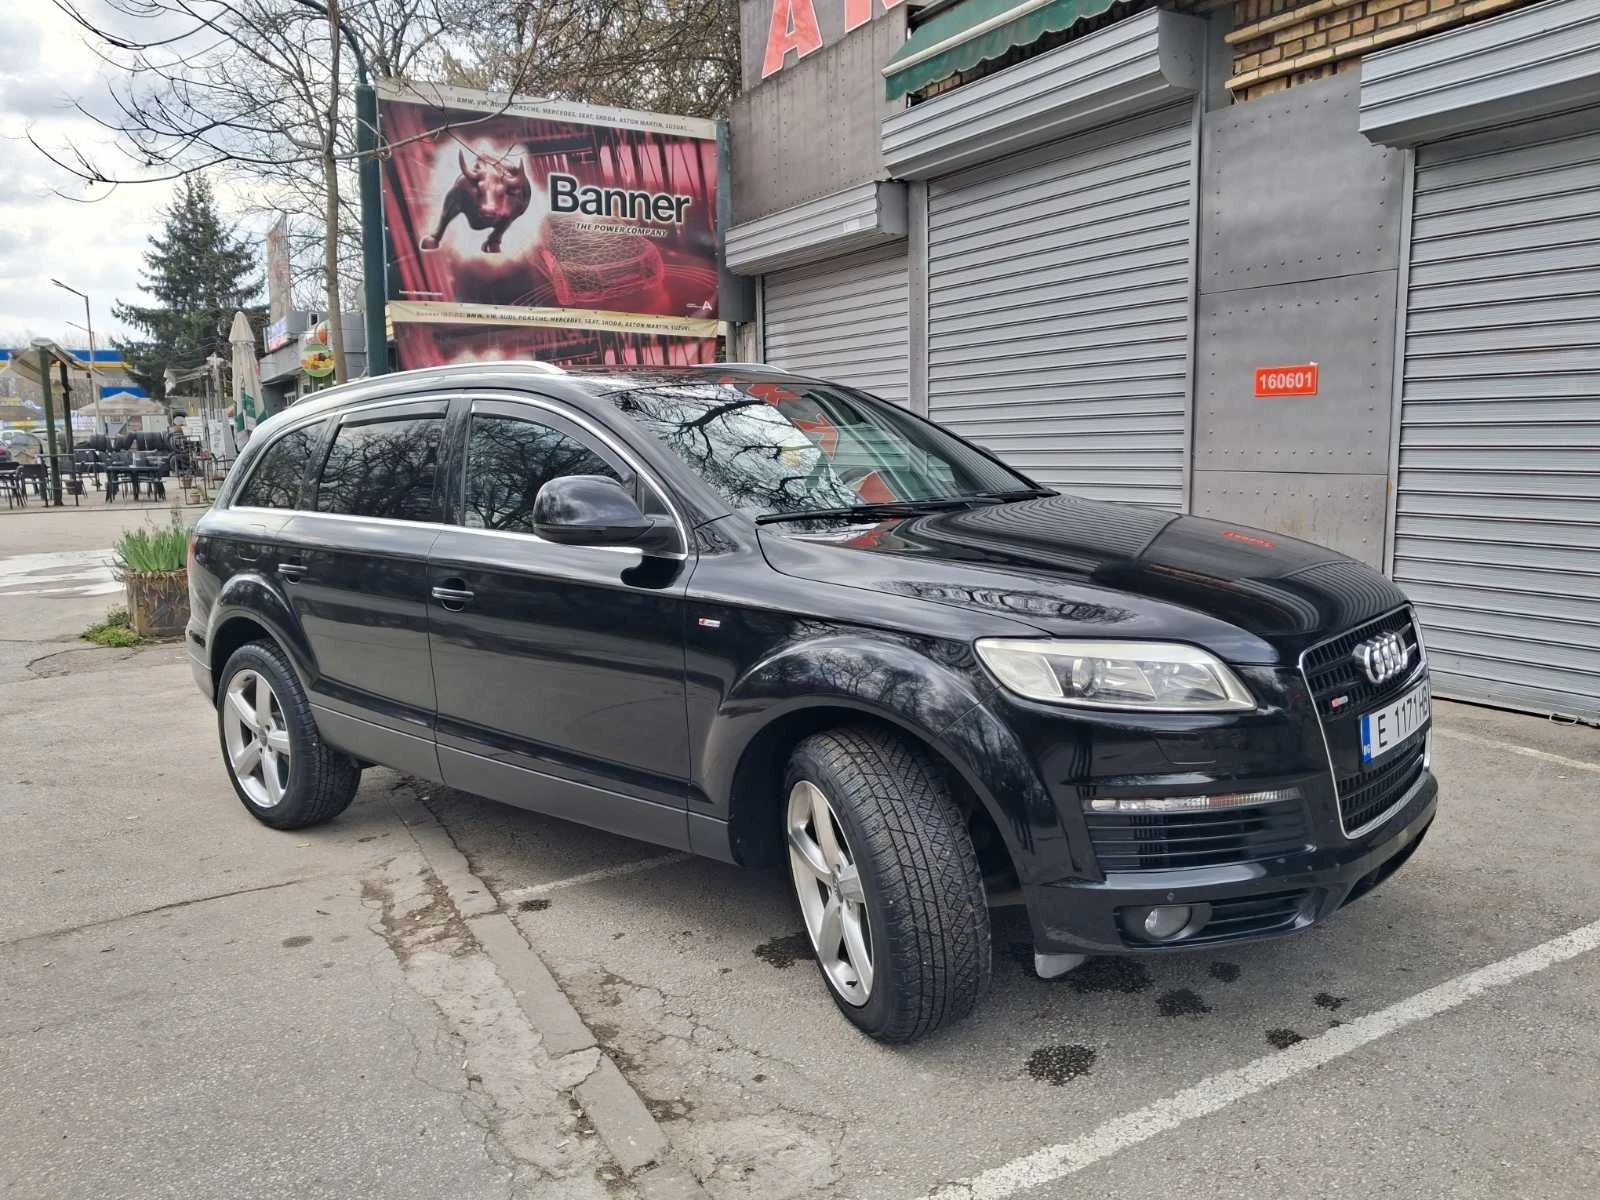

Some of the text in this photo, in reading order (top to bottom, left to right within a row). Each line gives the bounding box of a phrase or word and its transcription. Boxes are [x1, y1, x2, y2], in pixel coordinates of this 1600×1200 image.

[549, 172, 692, 224] Banner
[575, 222, 667, 237] THE POWER COMPANY
[1259, 371, 1312, 390] 160601
[1377, 713, 1388, 748] E
[1395, 694, 1418, 737] 1171
